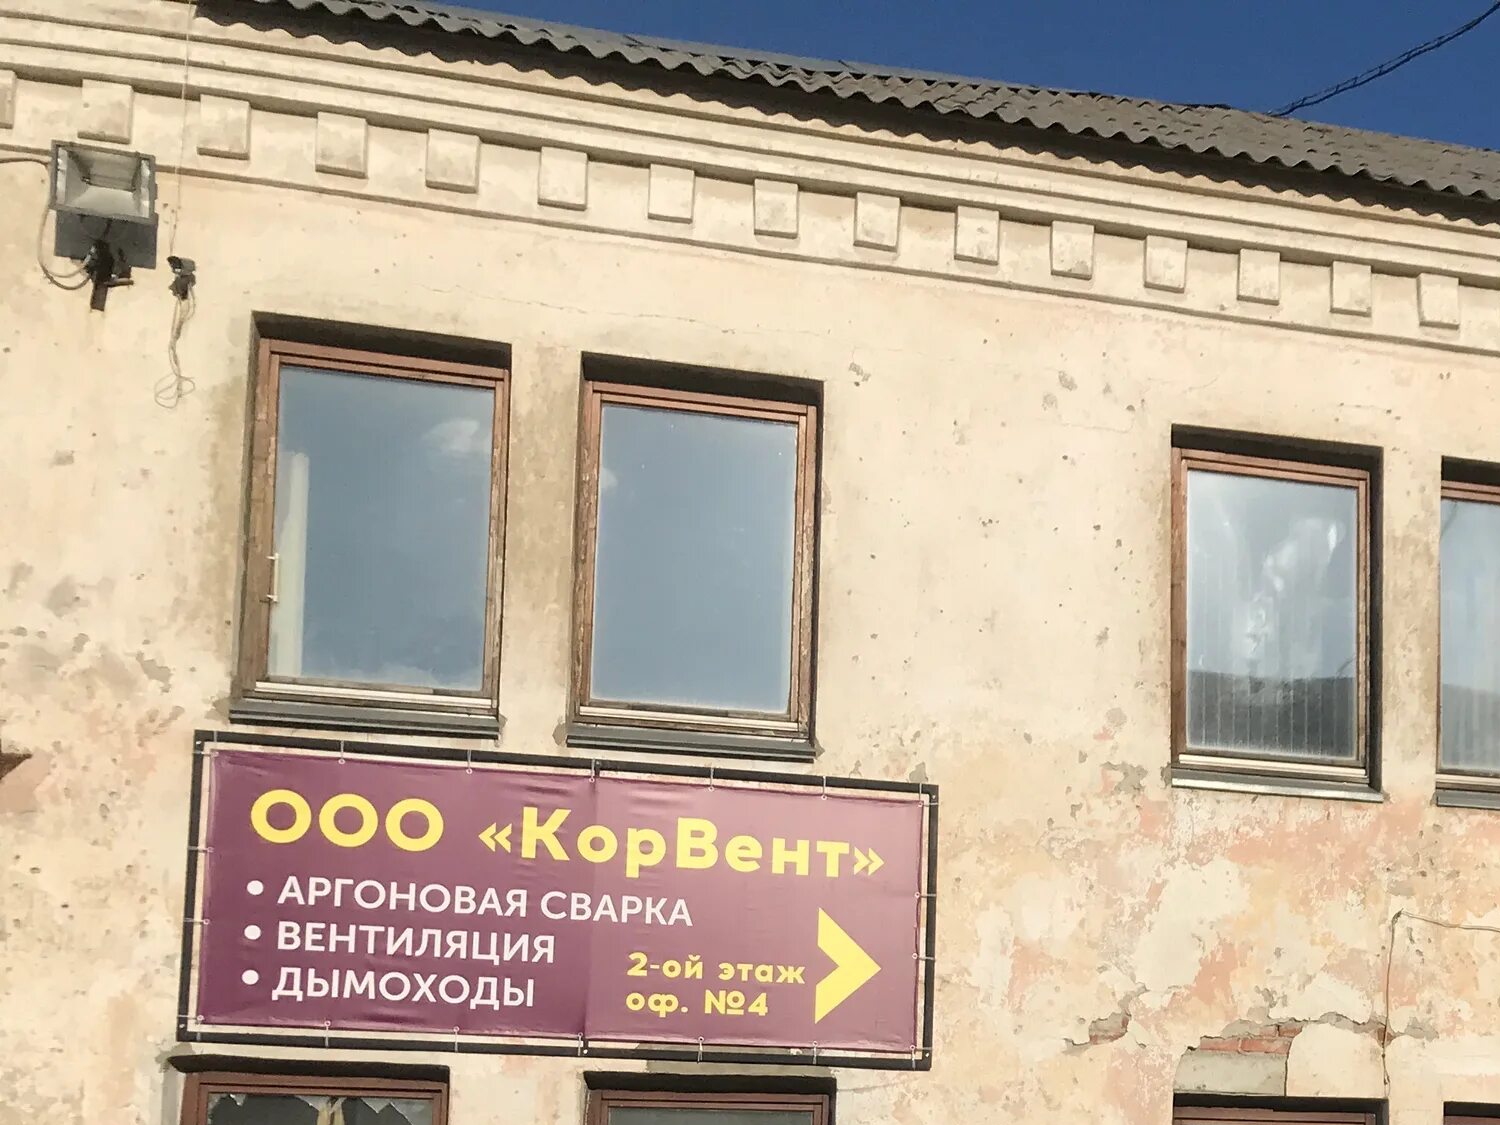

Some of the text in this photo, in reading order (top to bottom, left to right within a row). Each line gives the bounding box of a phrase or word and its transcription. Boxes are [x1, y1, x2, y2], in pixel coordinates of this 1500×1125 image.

[250, 788, 886, 879] ООО «КорВент»
[277, 875, 694, 927] АРГОНОВАЯ СВАРКА
[277, 922, 556, 965] ВЕНТИЛЯЦИЯ
[272, 966, 535, 1009] ДЫМОХОДЫ
[627, 951, 806, 985] 2-ой этаж
[626, 988, 769, 1017] оф. №4
